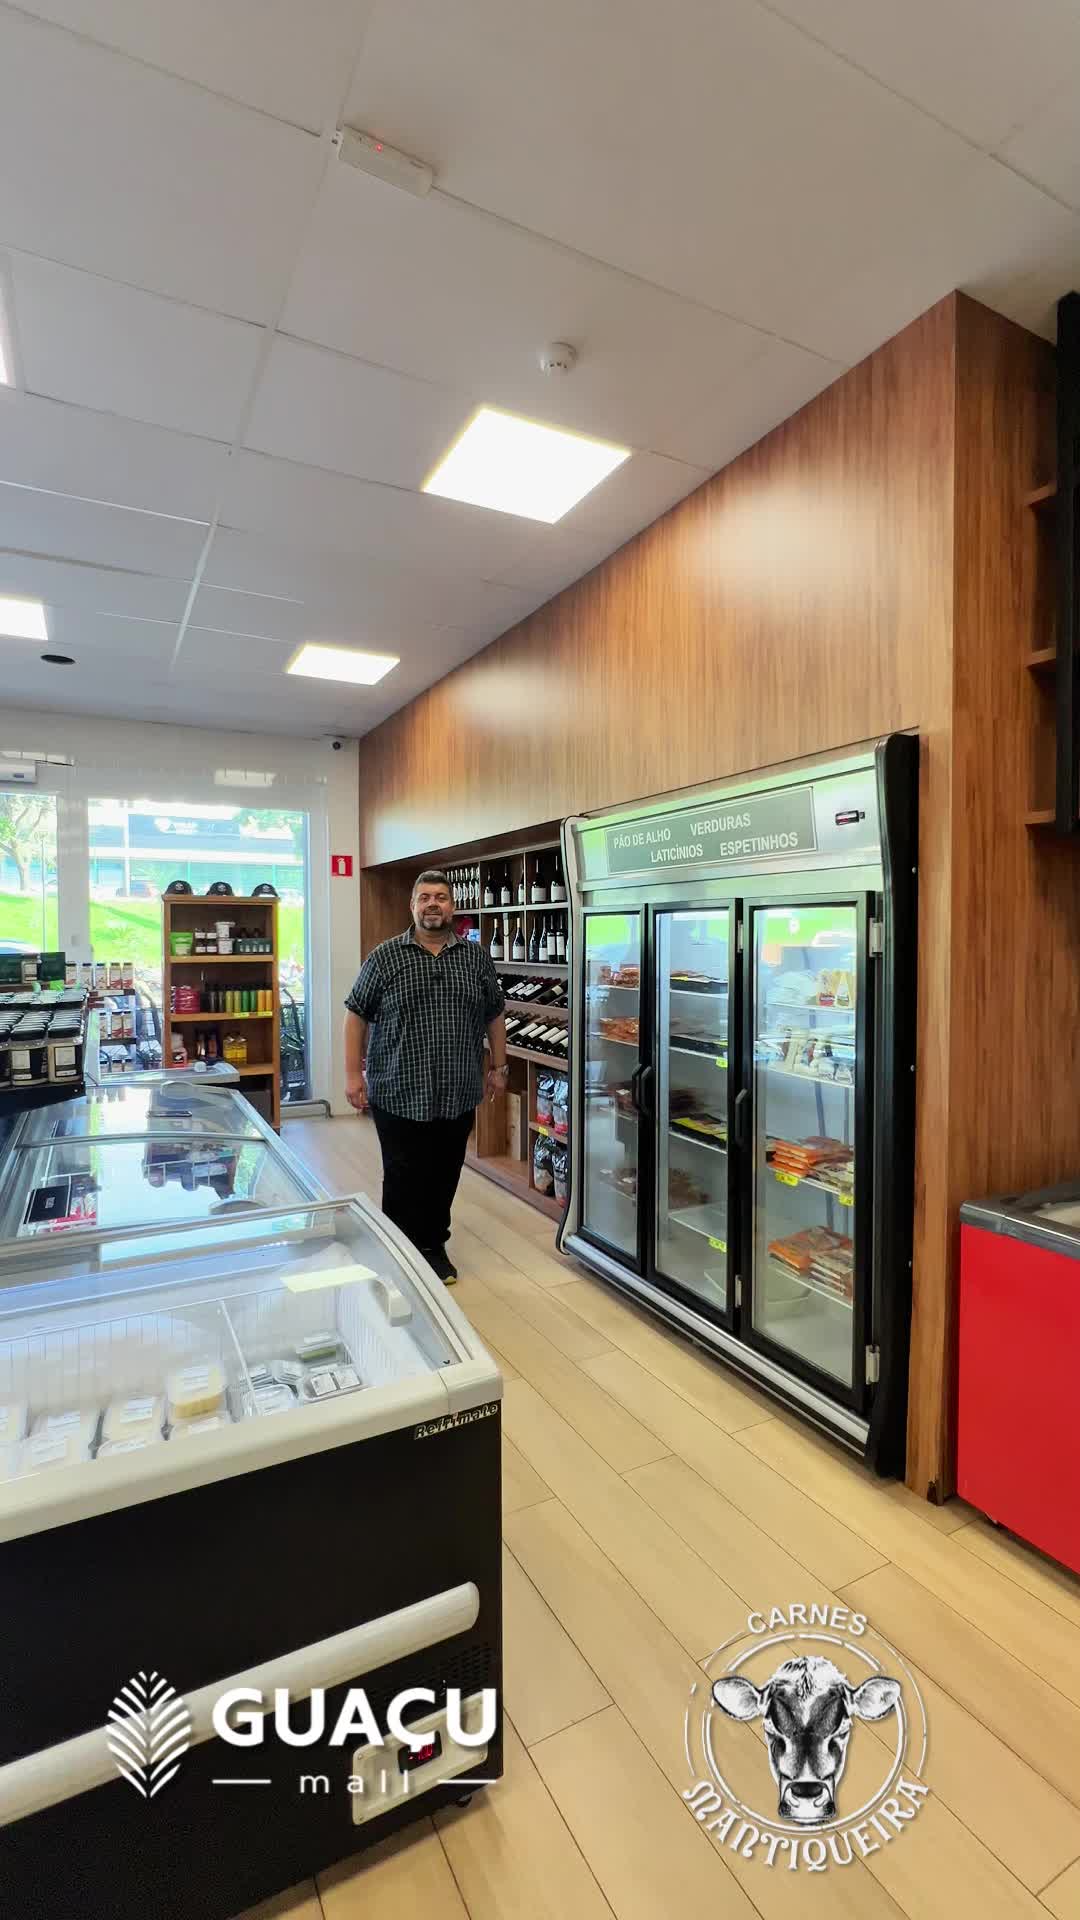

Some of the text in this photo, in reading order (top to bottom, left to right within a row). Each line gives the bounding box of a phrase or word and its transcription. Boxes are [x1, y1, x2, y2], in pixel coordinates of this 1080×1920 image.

[690, 812, 751, 836] VERDURAS
[632, 832, 644, 846] DE
[646, 828, 671, 844] ALHO
[720, 831, 799, 857] ESPETINHOS
[651, 843, 704, 863] LATICÍNIOS
